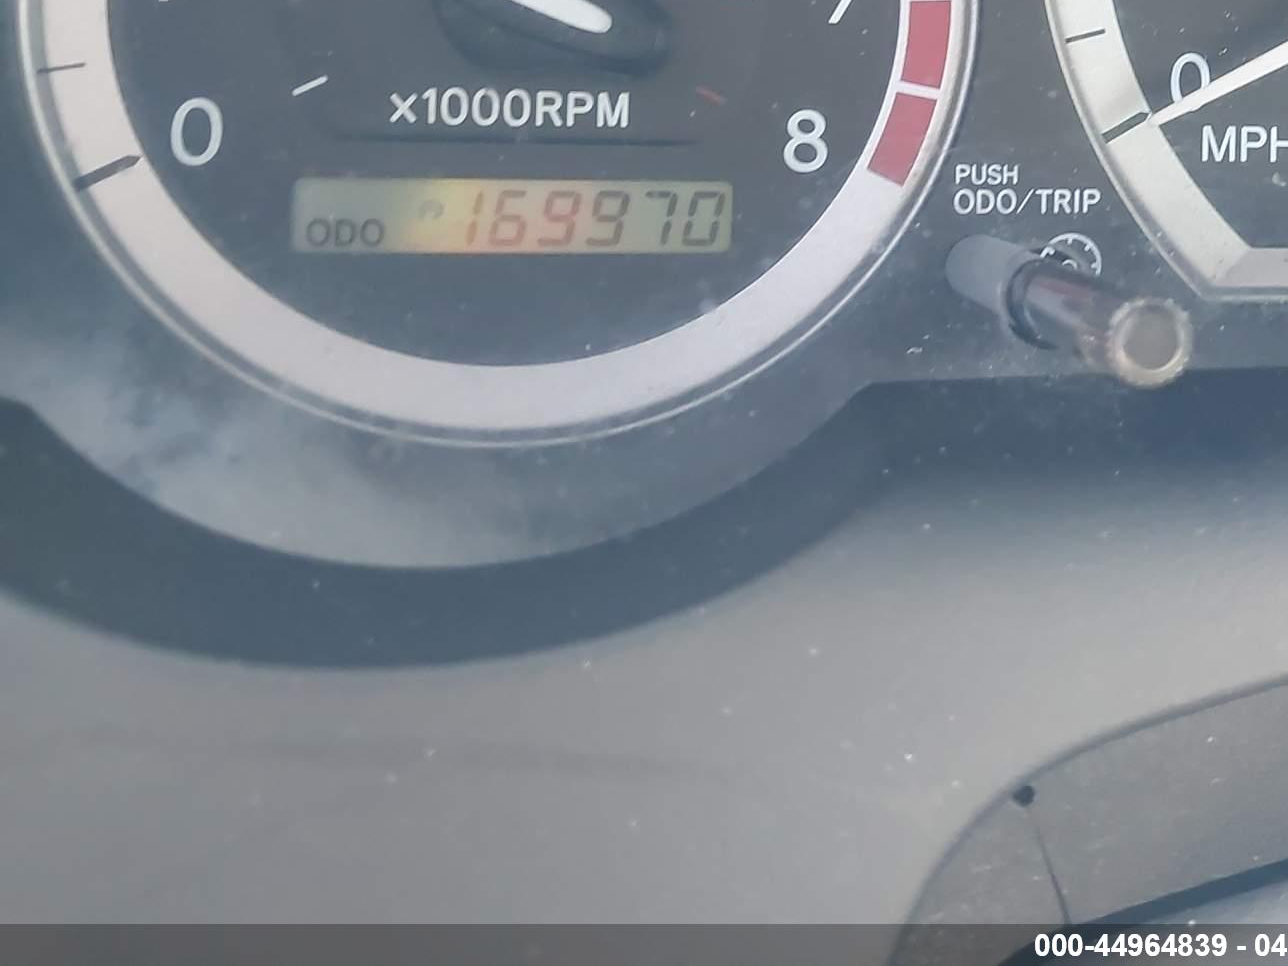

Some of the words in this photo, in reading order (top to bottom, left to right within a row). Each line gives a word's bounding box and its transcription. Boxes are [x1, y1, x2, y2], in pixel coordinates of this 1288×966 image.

[1169, 52, 1212, 112] 0
[170, 97, 223, 166] 0
[783, 109, 828, 173] 8
[953, 188, 1101, 215] ODO/TRIP
[955, 163, 1019, 187] PUSH
[305, 217, 386, 248] ODO
[463, 189, 727, 248] 169970
